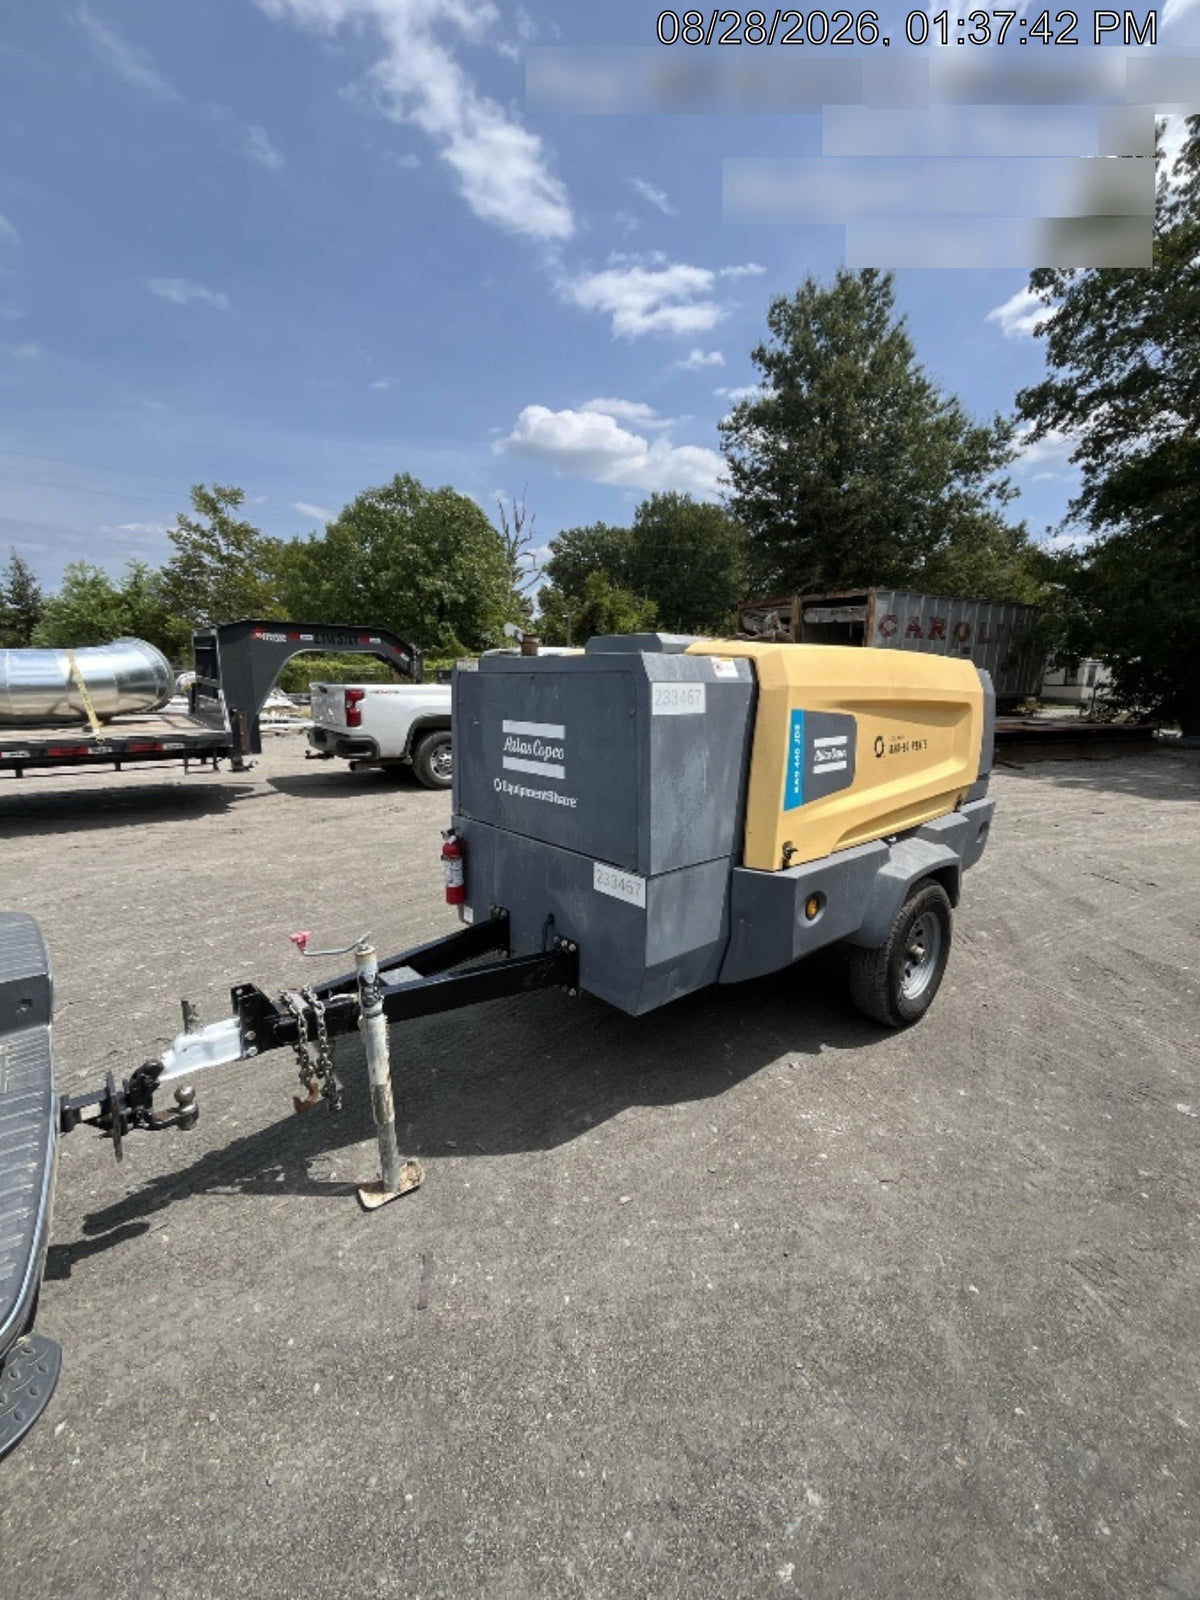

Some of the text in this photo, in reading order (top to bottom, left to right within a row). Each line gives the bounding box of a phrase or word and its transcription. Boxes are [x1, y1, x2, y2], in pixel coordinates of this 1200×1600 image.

[654, 689, 702, 706] 233467
[503, 736, 564, 761] Atlas Copco
[596, 868, 642, 897] 233467
